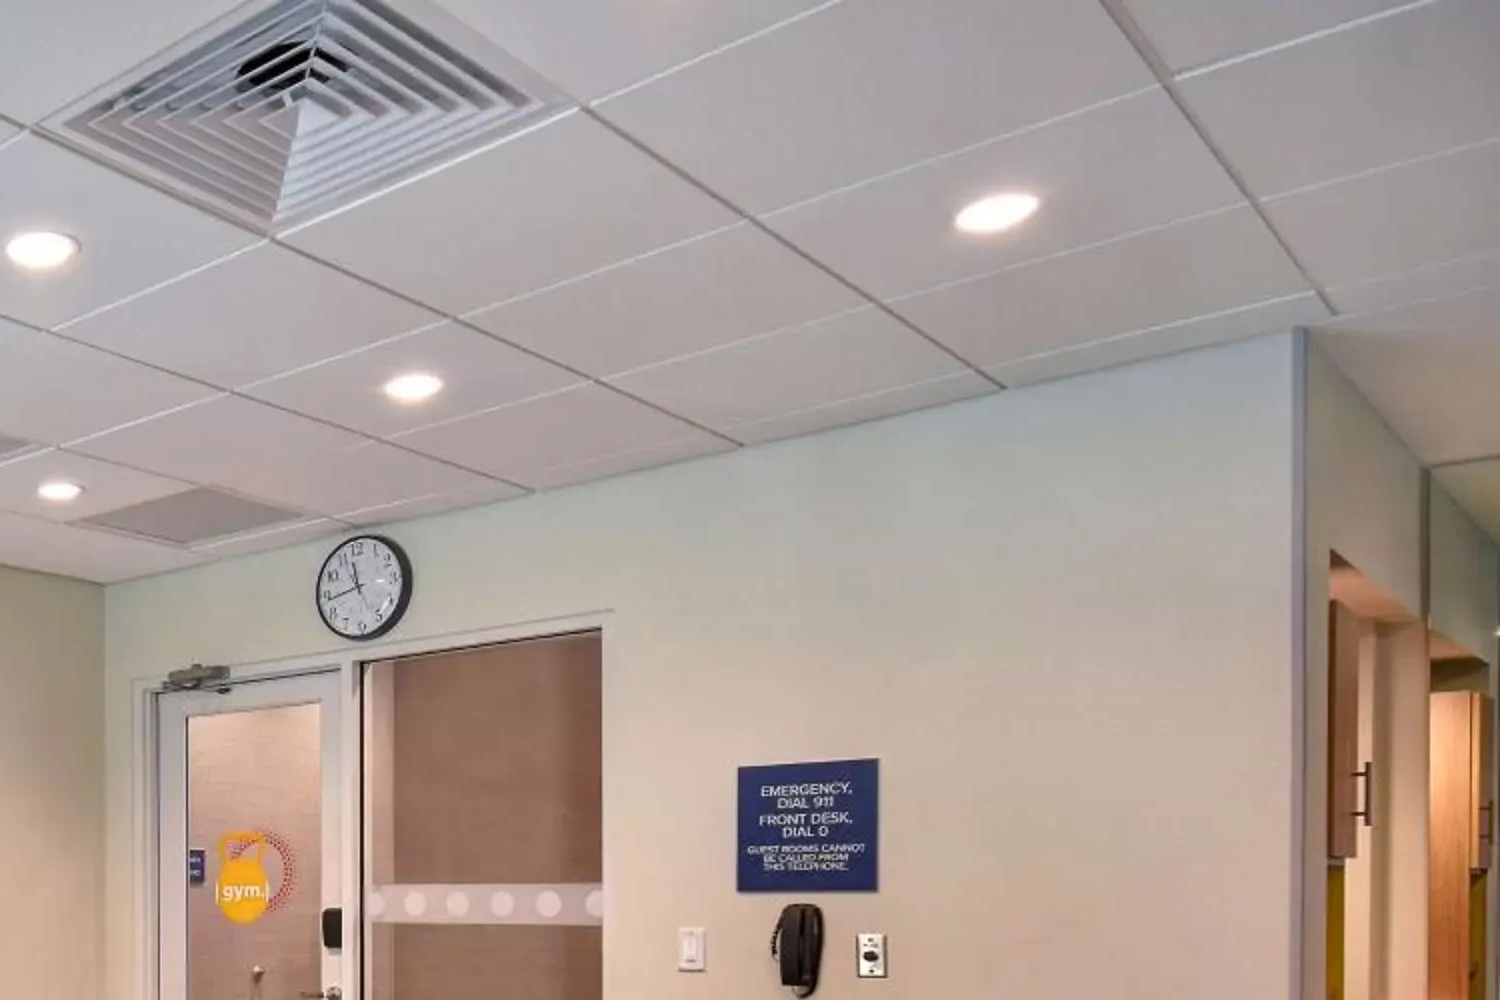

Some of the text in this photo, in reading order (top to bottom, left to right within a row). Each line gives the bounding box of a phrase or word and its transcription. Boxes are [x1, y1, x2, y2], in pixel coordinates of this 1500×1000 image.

[351, 541, 364, 557] 12
[777, 795, 834, 808] DIAL 911
[759, 812, 807, 826] FRONT
[782, 826, 815, 838] DIAL
